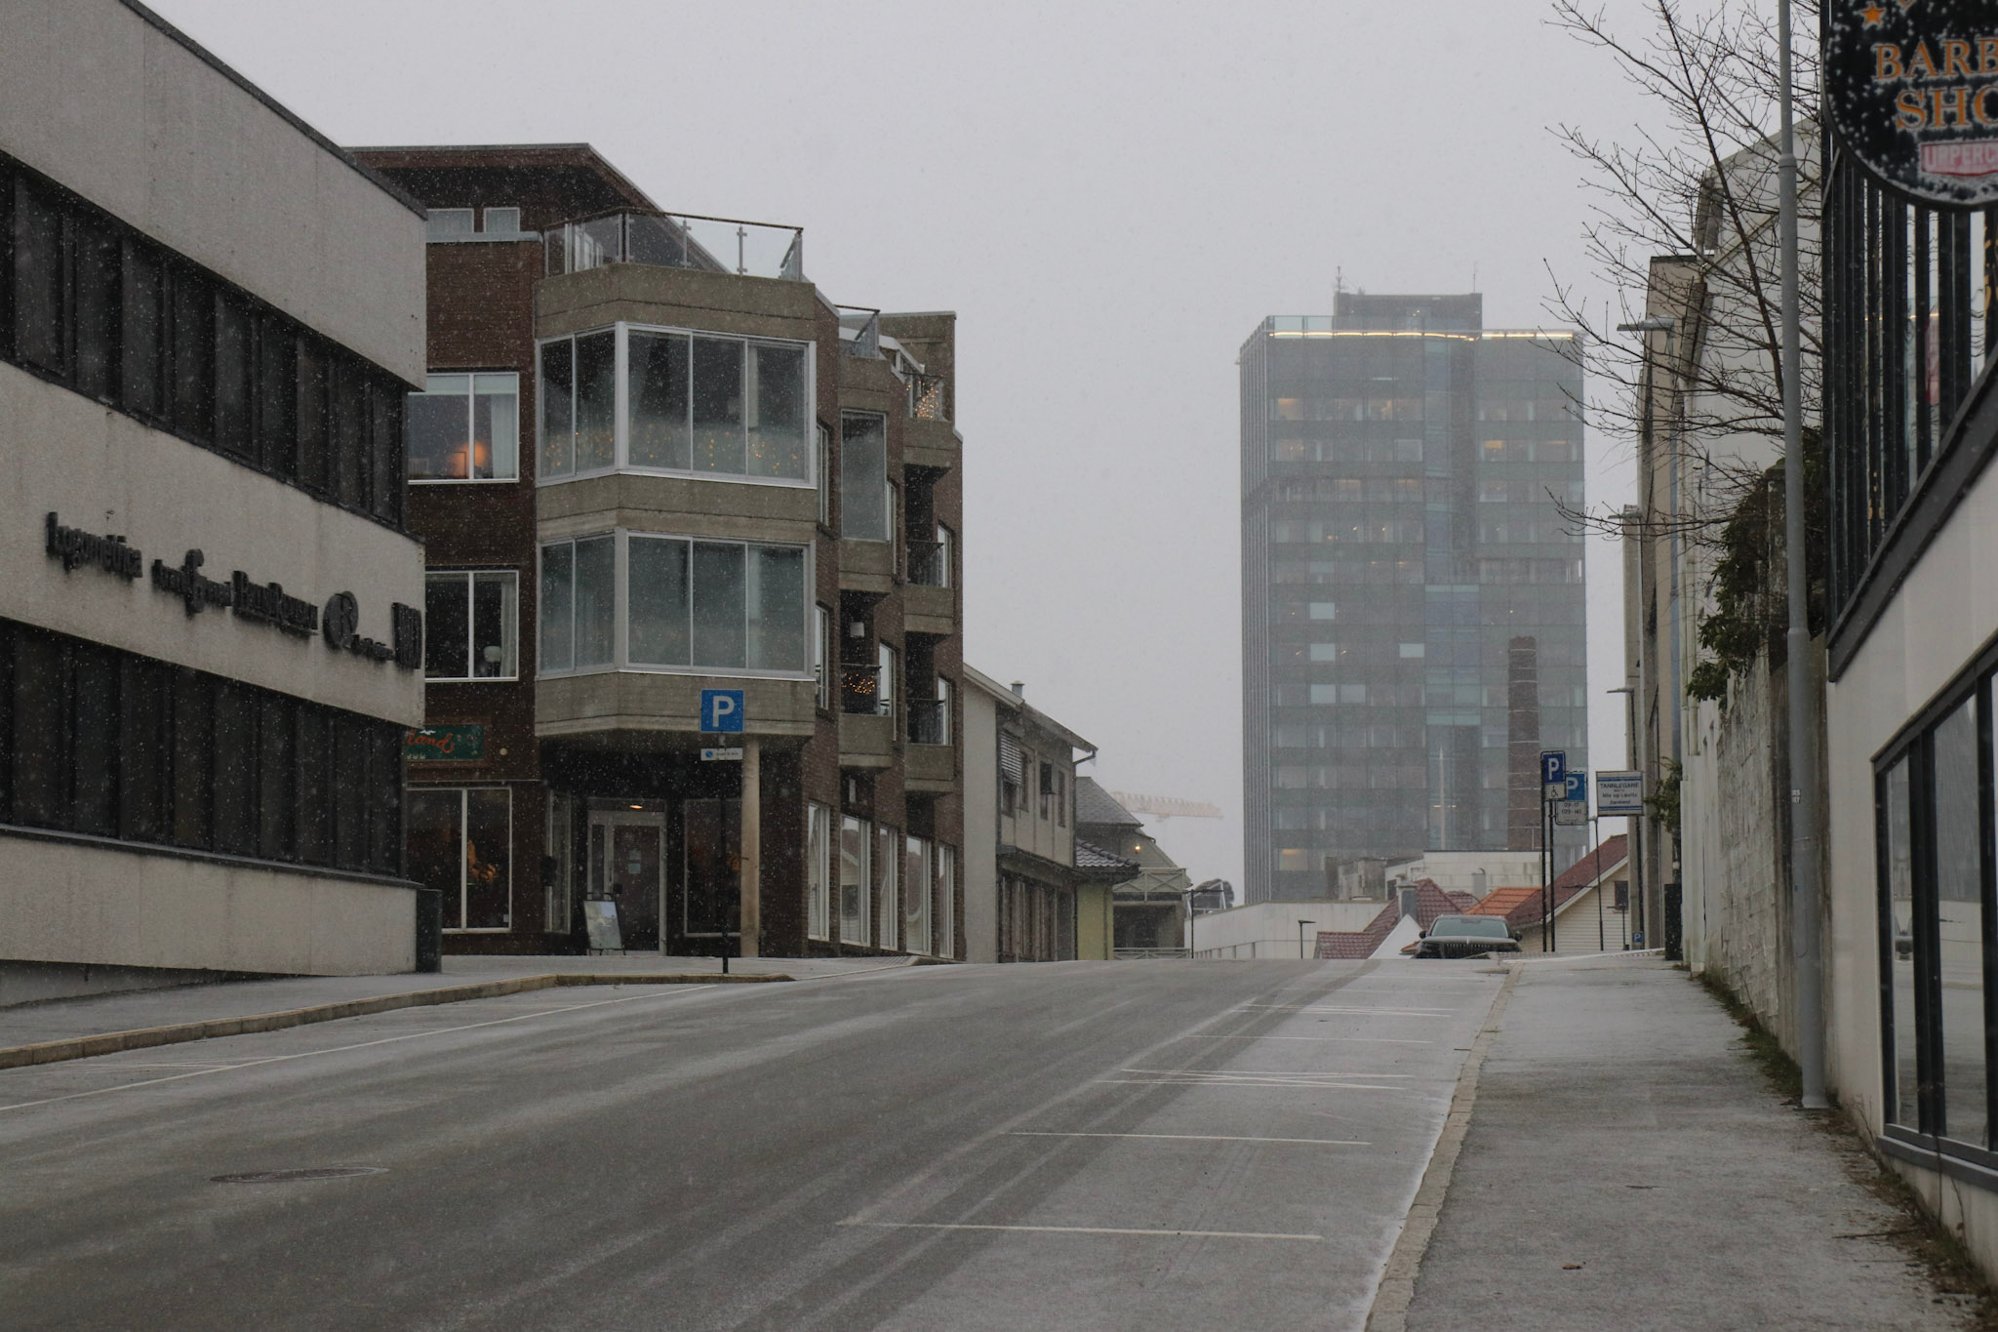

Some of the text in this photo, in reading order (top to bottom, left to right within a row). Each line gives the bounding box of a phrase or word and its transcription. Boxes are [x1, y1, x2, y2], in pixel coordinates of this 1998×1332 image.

[1872, 37, 1998, 82] BARB
[712, 695, 735, 728] P
[1548, 757, 1560, 781] P
[1566, 777, 1579, 797] P
[1633, 933, 1641, 942] P
